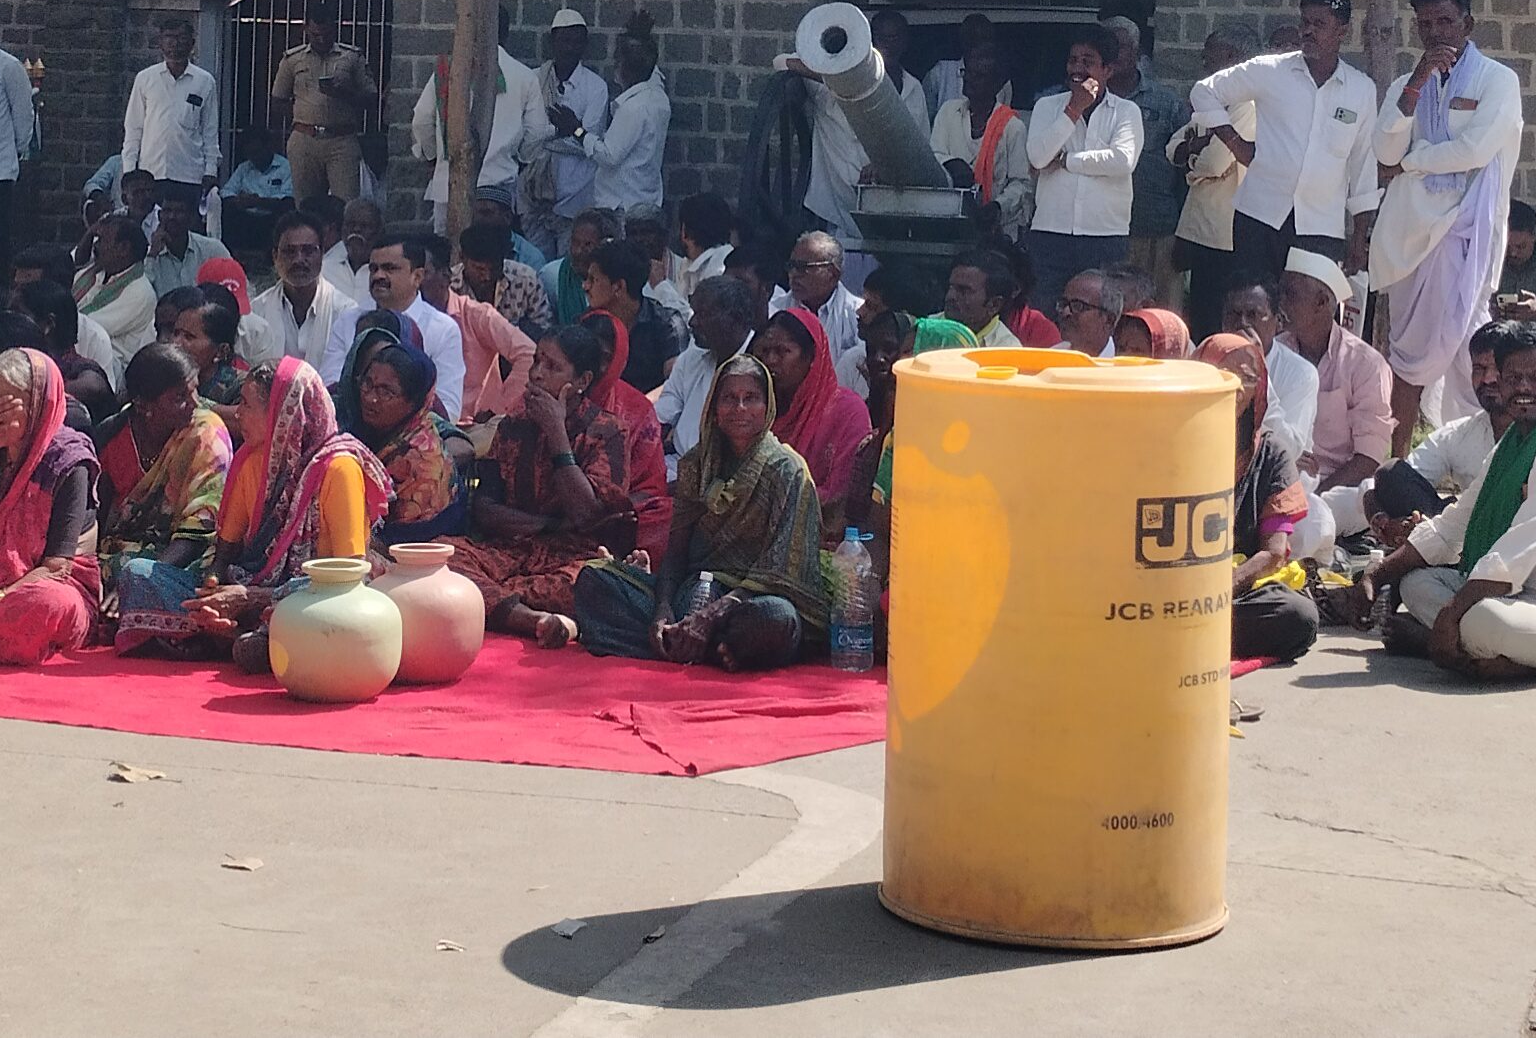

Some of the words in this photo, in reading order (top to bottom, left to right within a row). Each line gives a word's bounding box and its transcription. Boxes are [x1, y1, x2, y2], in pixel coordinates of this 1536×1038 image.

[1105, 602, 1155, 621] JCB
[1163, 597, 1213, 619] REAR
[1179, 674, 1199, 688] JCB
[1201, 670, 1219, 684] STD
